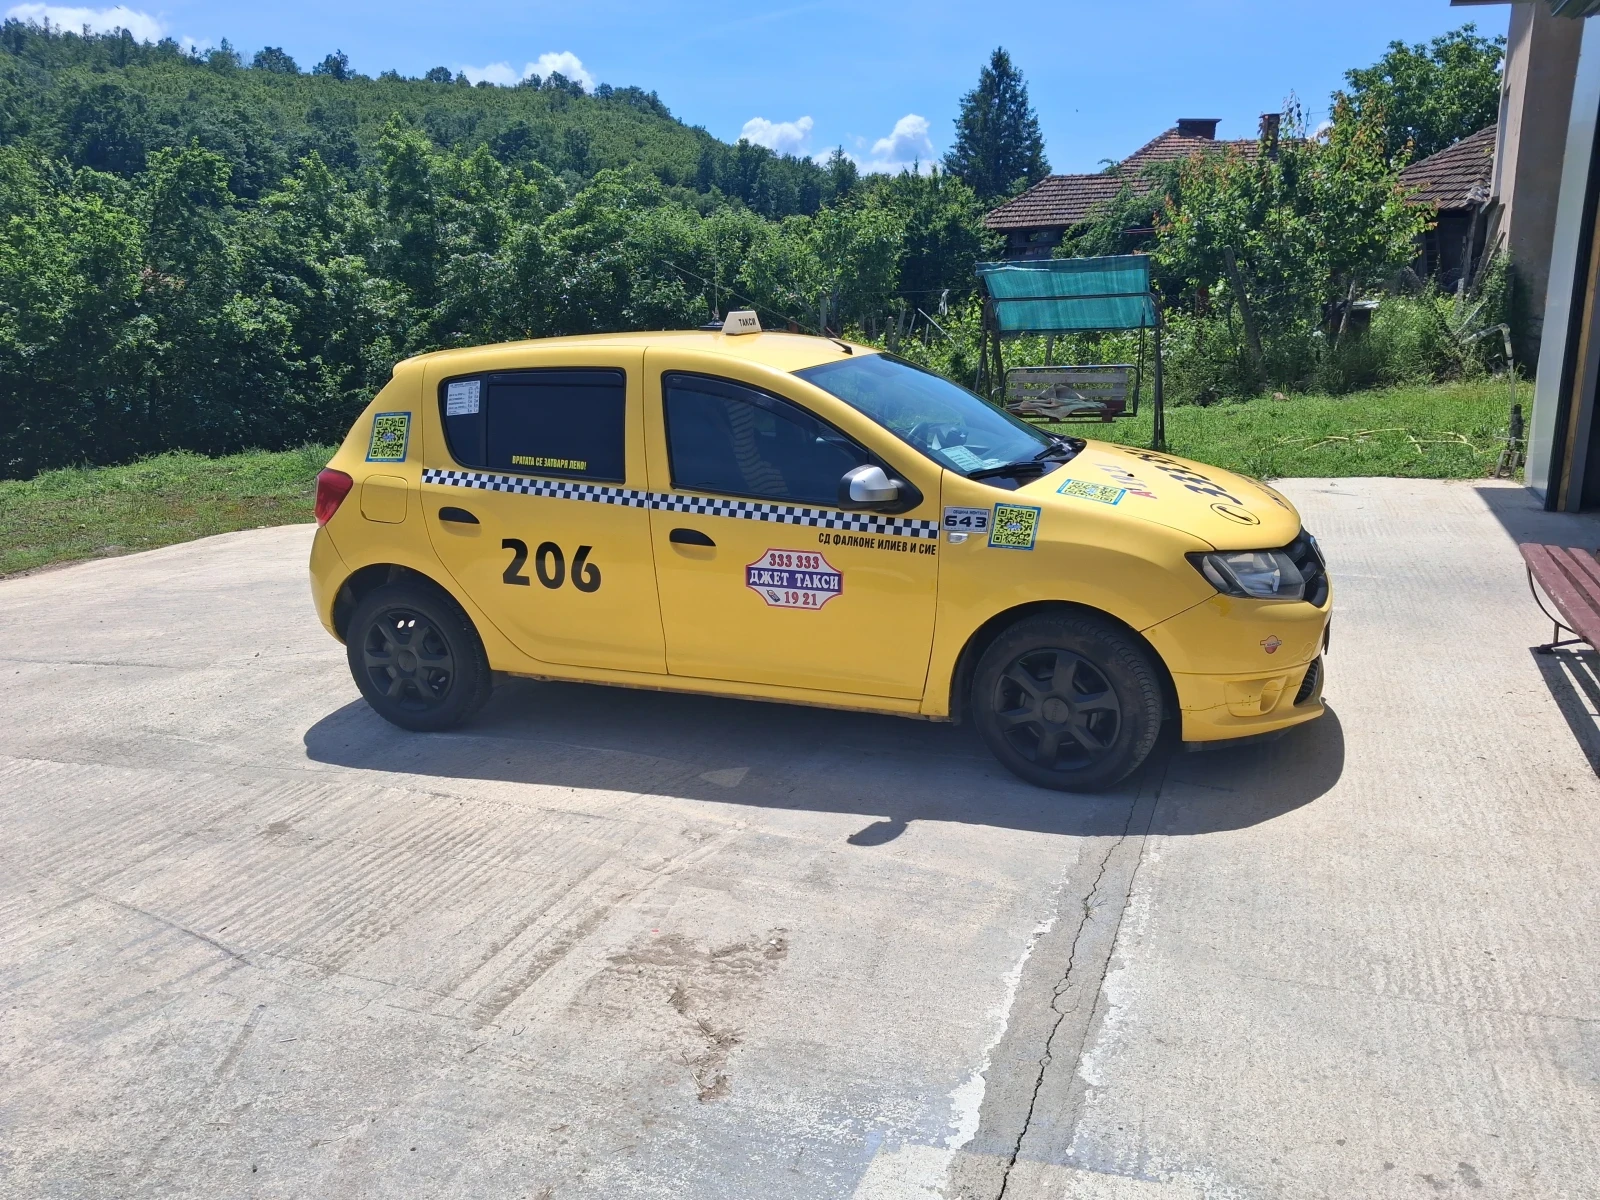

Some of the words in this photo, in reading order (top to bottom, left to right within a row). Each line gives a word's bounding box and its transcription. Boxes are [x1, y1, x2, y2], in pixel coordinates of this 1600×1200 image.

[738, 317, 757, 327] ТАКСИ
[535, 457, 544, 467] СЕ
[543, 458, 569, 469] ЗАТВАРЯ
[944, 515, 987, 528] 643
[818, 532, 831, 545] СД
[833, 535, 876, 549] ФАЛКОНЕ
[877, 538, 908, 552] ИЛИЕВ
[909, 543, 917, 553] И
[918, 544, 937, 556] СИЕ
[501, 537, 602, 593] 206
[769, 553, 792, 568] 333
[795, 554, 820, 570] 333
[749, 569, 790, 586] ДЖЕТ
[795, 573, 839, 590] ТАКСИ
[784, 590, 800, 605] 19
[802, 592, 818, 606] 21
